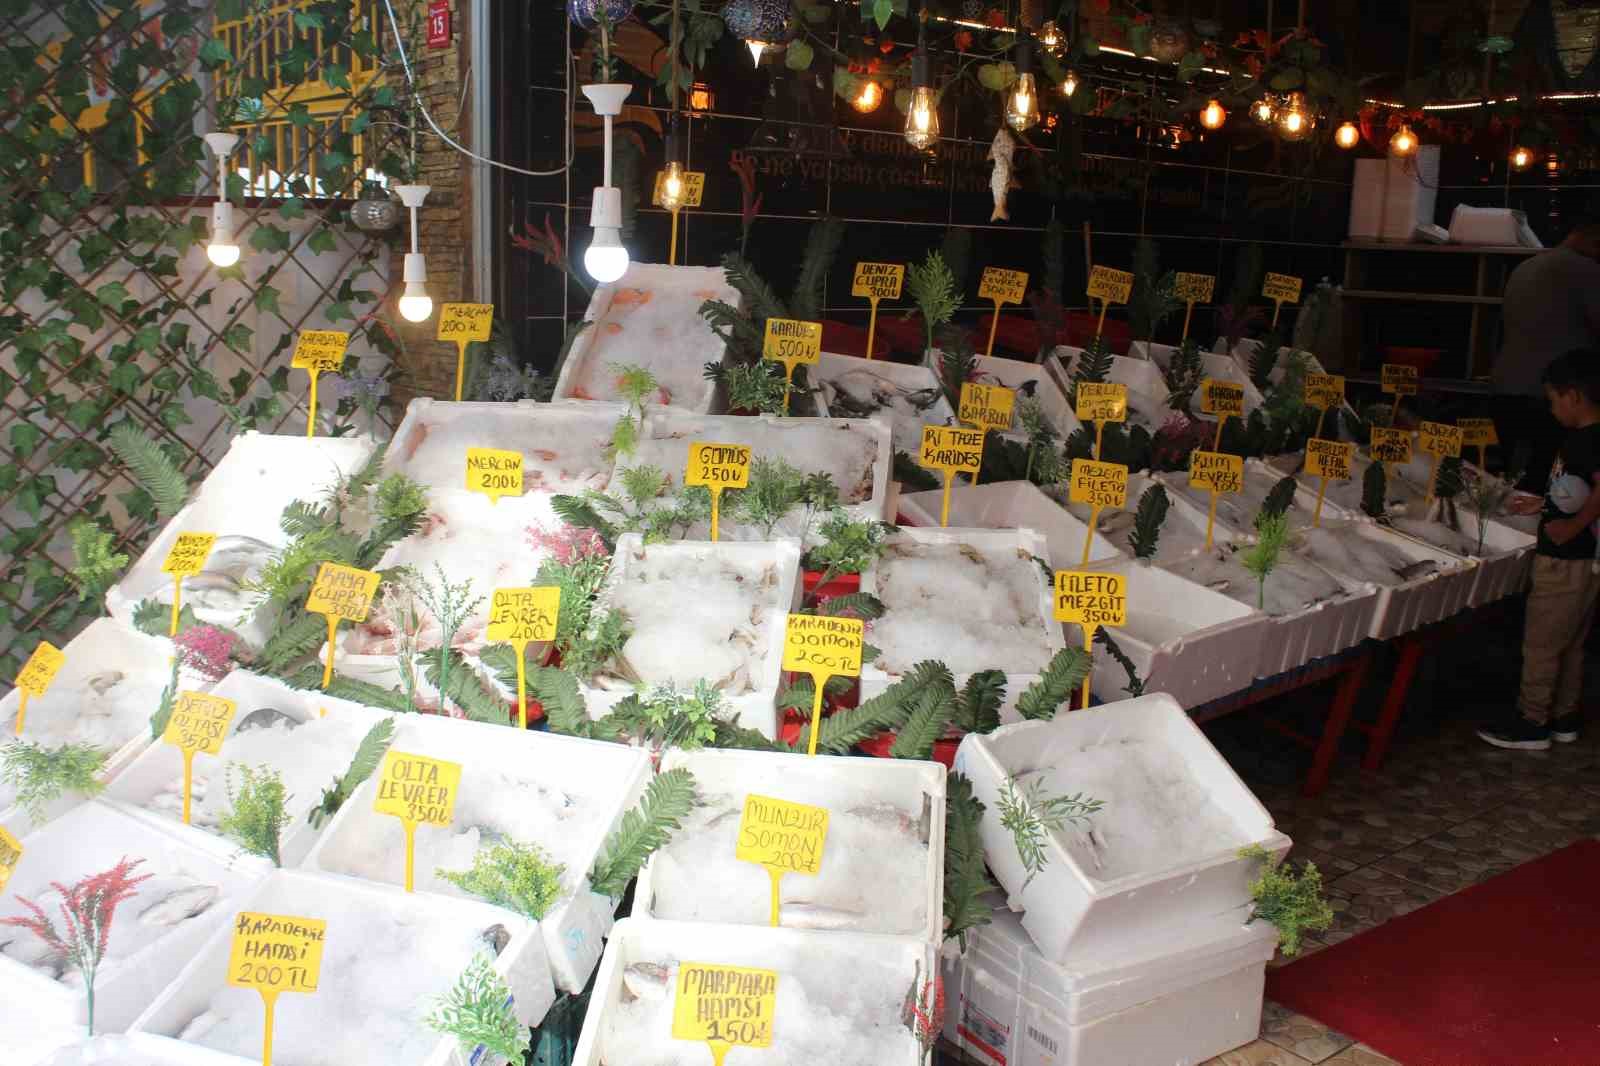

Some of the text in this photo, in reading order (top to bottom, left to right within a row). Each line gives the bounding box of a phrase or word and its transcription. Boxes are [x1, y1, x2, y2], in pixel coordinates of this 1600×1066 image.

[433, 15, 444, 35] 15
[391, 758, 439, 785] OLTA
[740, 825, 818, 857] SOMON
